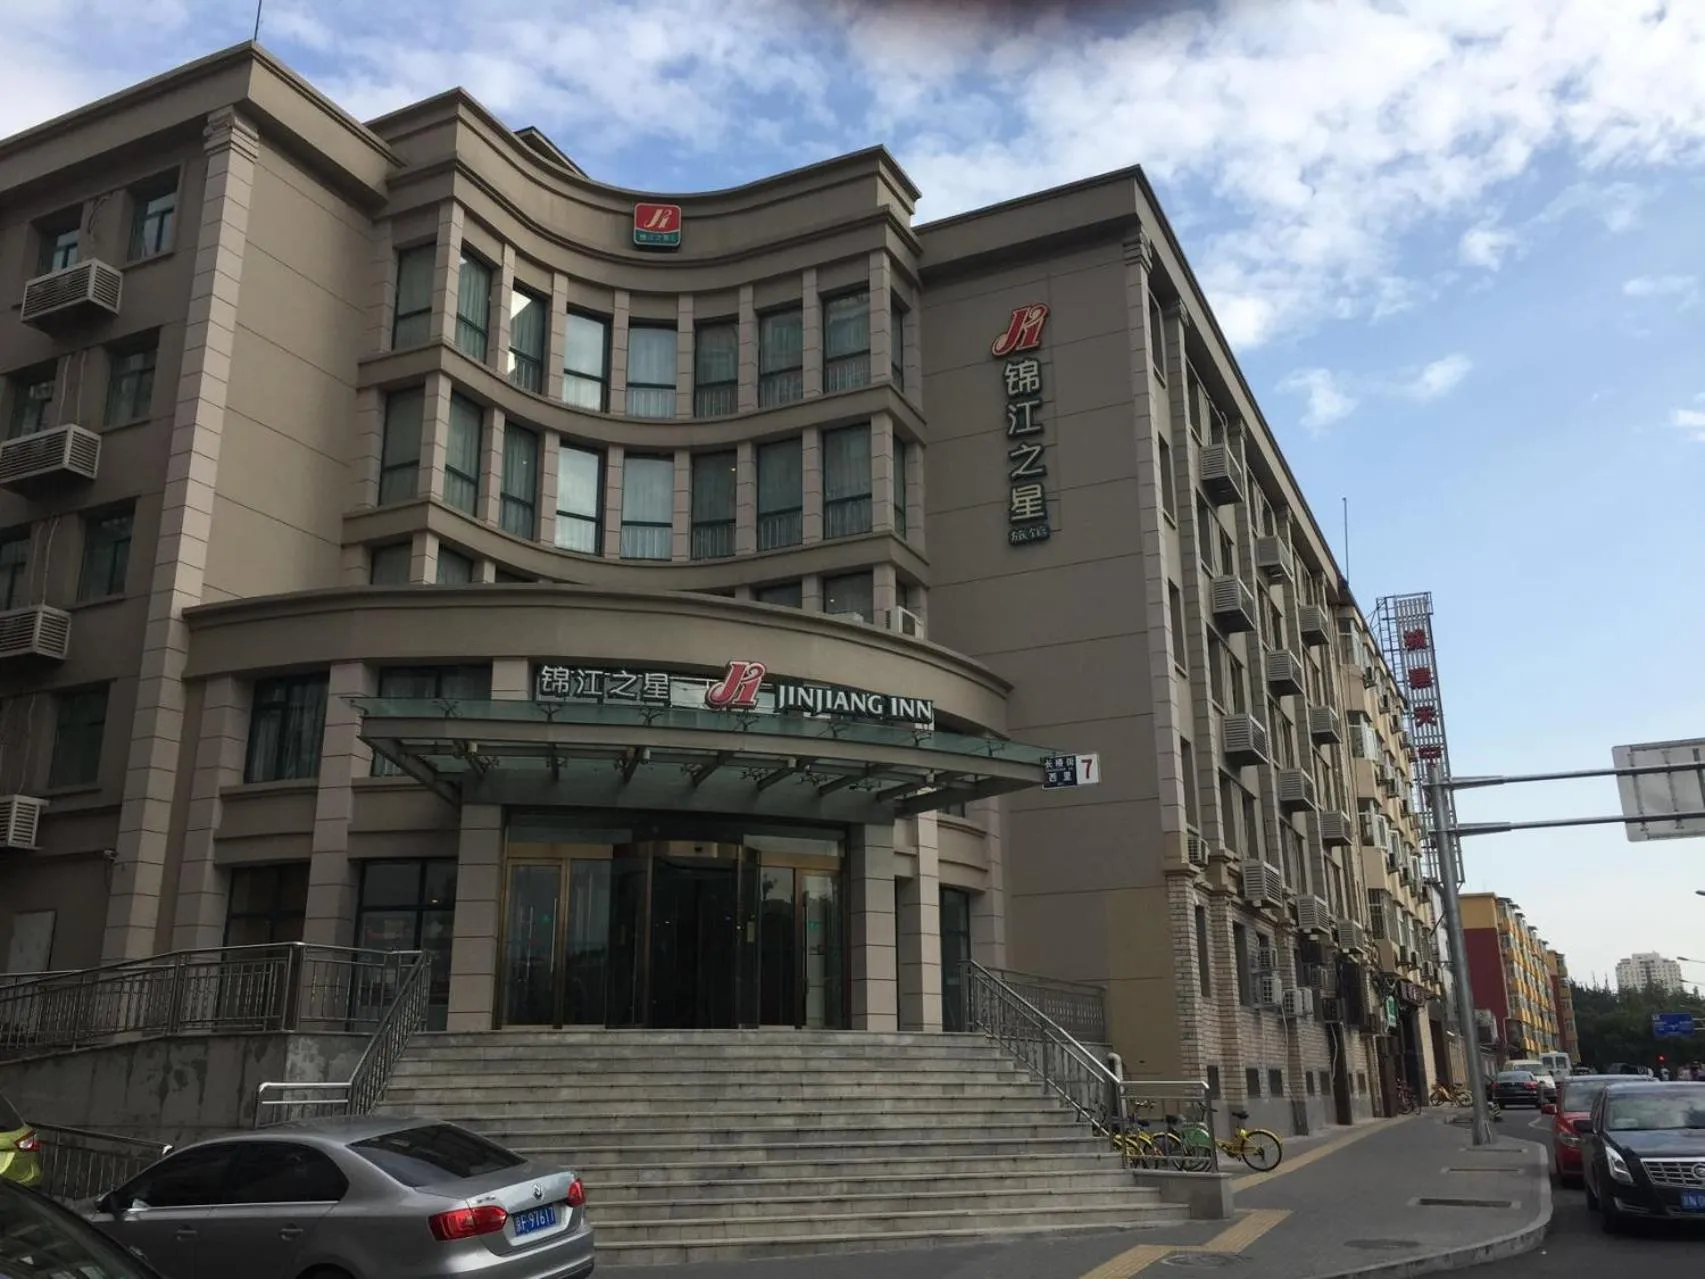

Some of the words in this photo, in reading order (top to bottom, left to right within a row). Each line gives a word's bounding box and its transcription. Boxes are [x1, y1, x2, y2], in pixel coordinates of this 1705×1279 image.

[1004, 359, 1045, 522] 锦江之星
[541, 665, 670, 700] 锦江之星
[778, 684, 884, 716] JINJIANG
[890, 697, 933, 720] INN
[1081, 758, 1093, 779] 7
